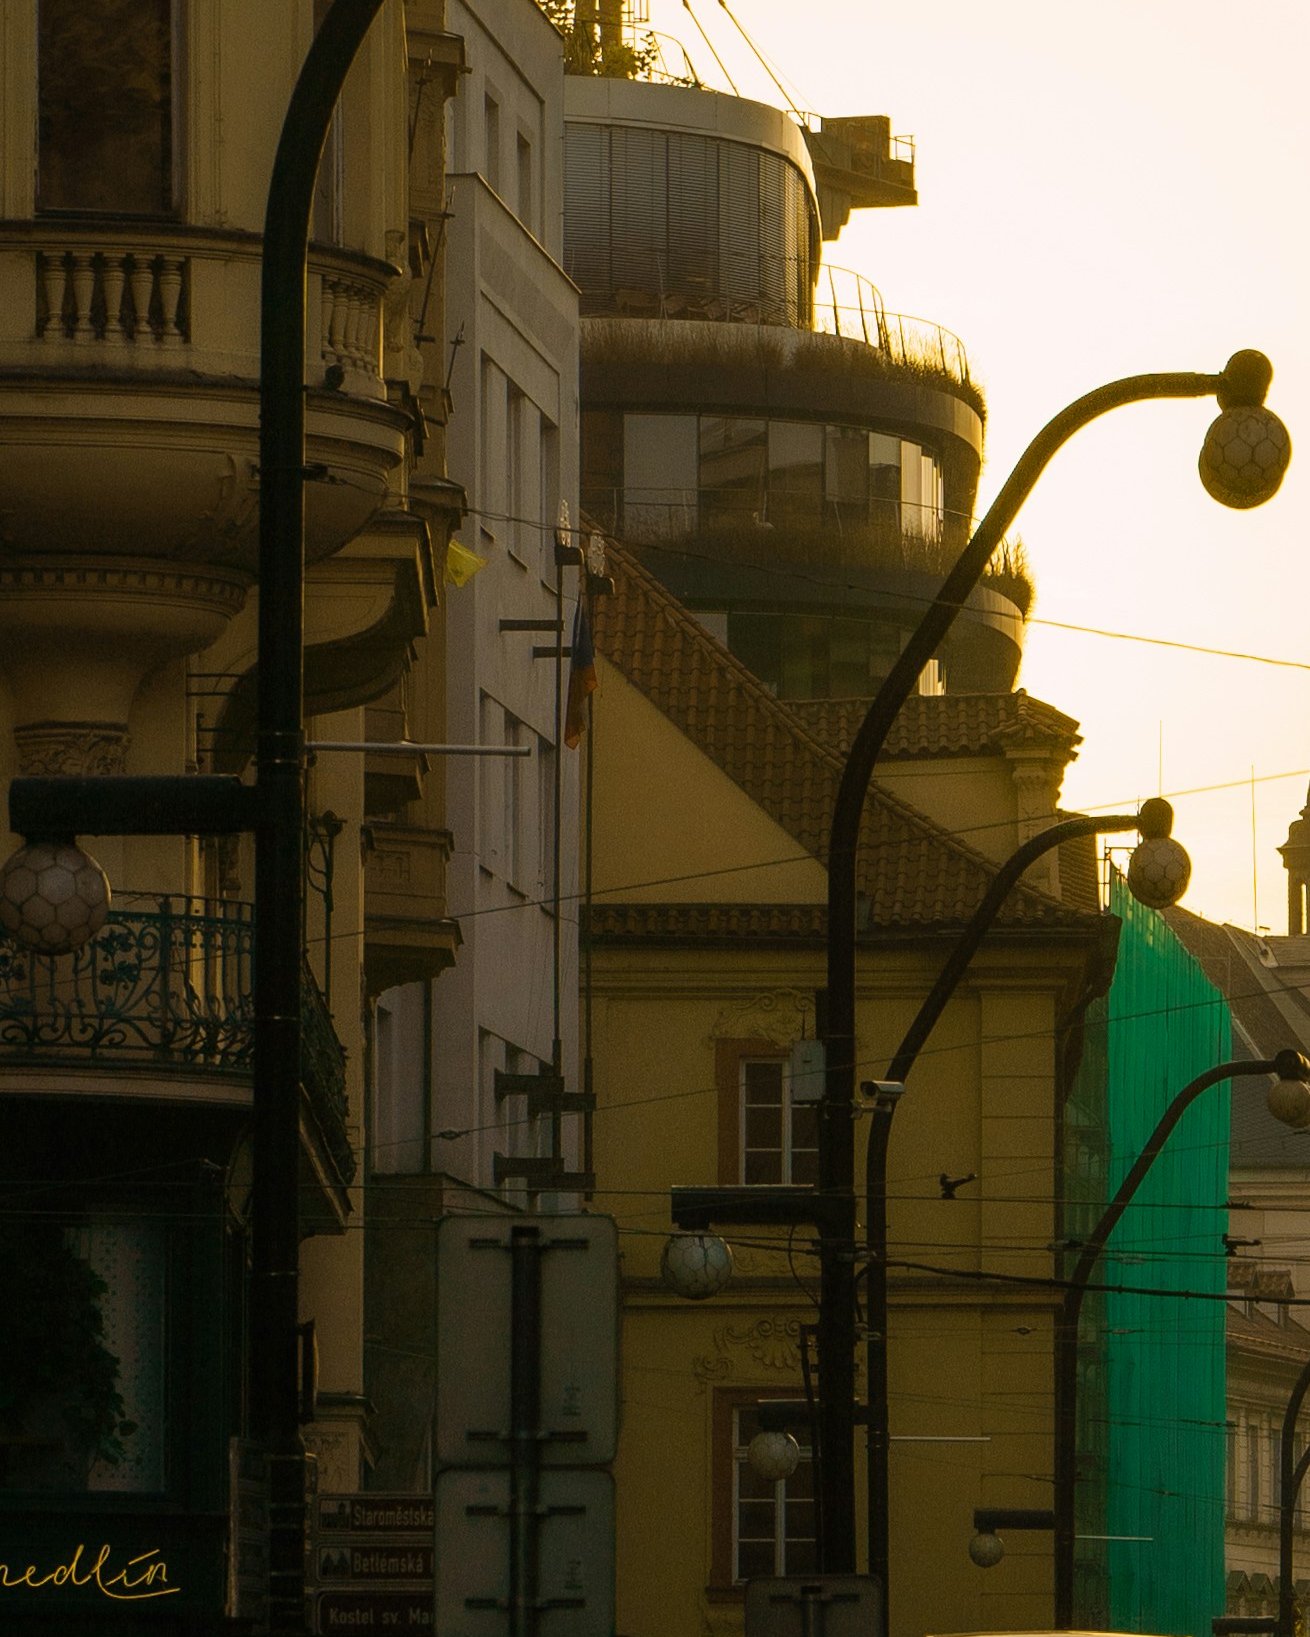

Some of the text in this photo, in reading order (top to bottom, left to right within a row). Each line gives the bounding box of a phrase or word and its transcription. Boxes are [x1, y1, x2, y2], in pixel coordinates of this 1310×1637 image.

[353, 1551, 424, 1573] Betlémská
[329, 1607, 374, 1625] Kostel
[382, 1610, 402, 1625] sv.
